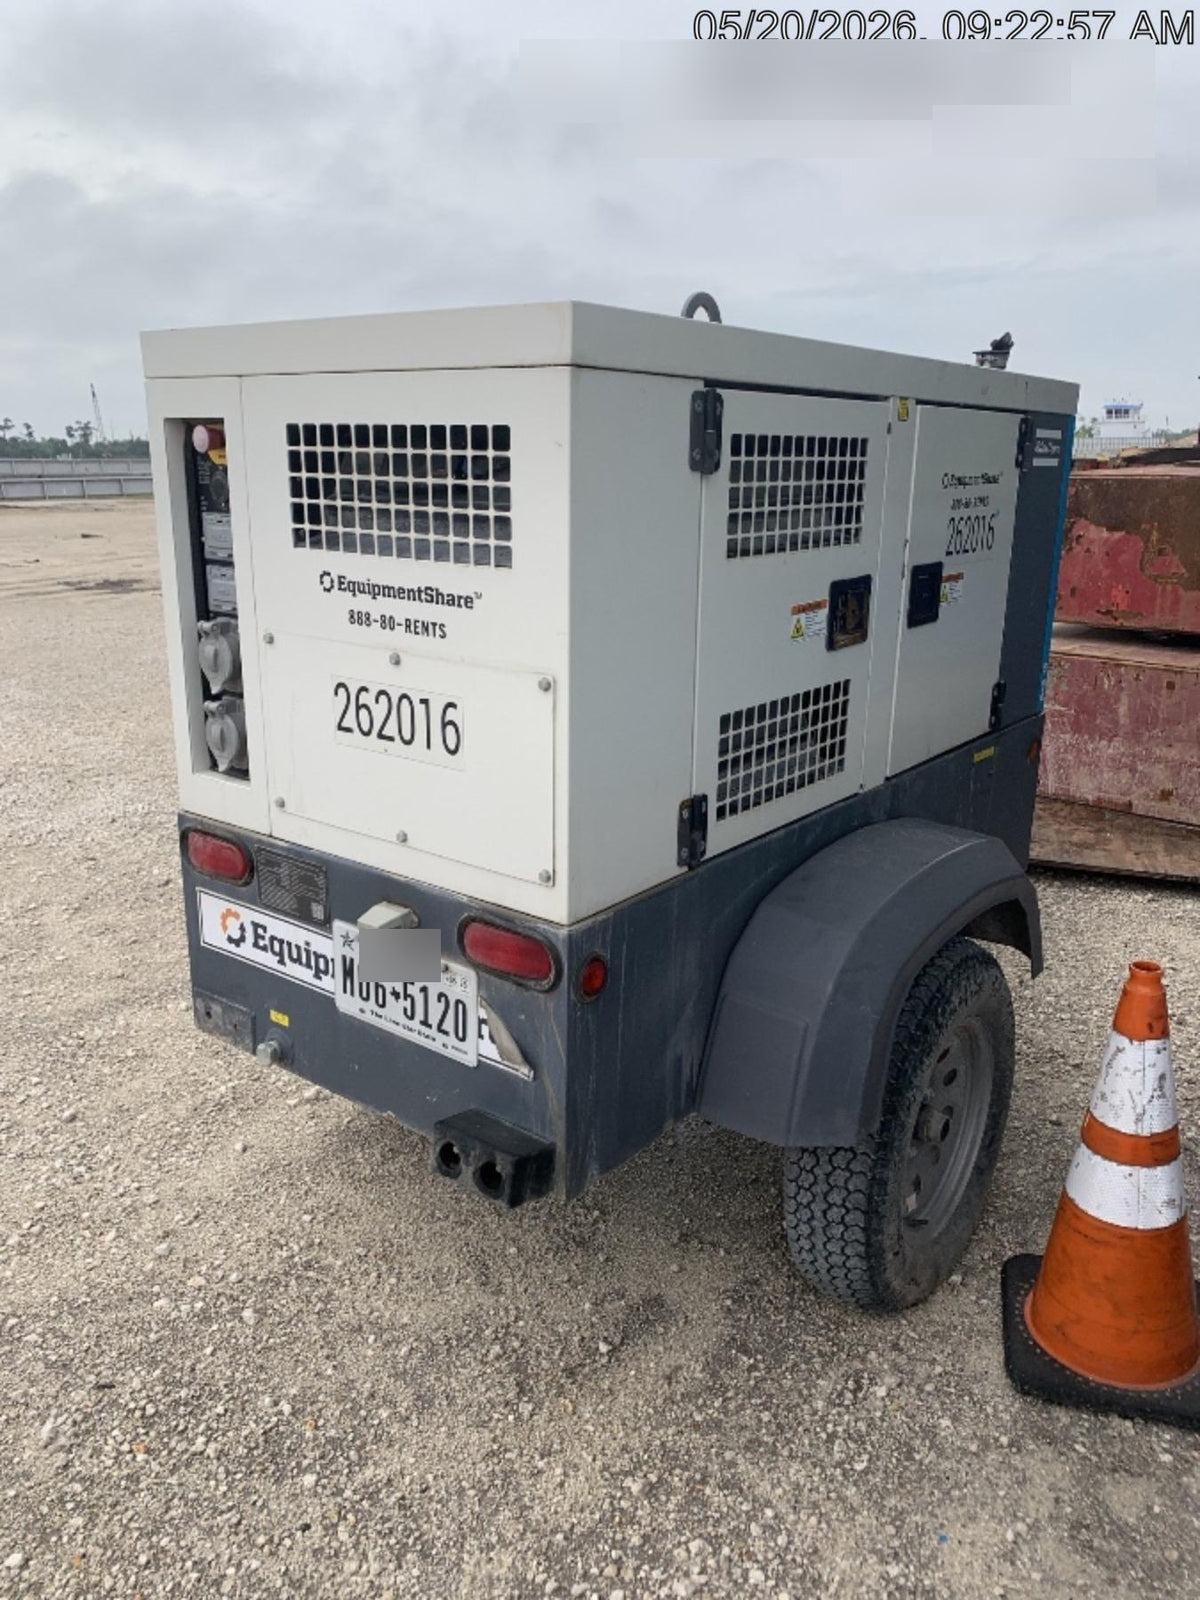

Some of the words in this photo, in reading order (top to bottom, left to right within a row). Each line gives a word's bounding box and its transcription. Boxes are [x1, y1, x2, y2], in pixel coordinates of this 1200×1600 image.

[945, 513, 996, 557] 262016
[348, 609, 447, 639] 888-80-RENTS
[334, 682, 461, 756] 262016
[251, 920, 335, 982] Equip
